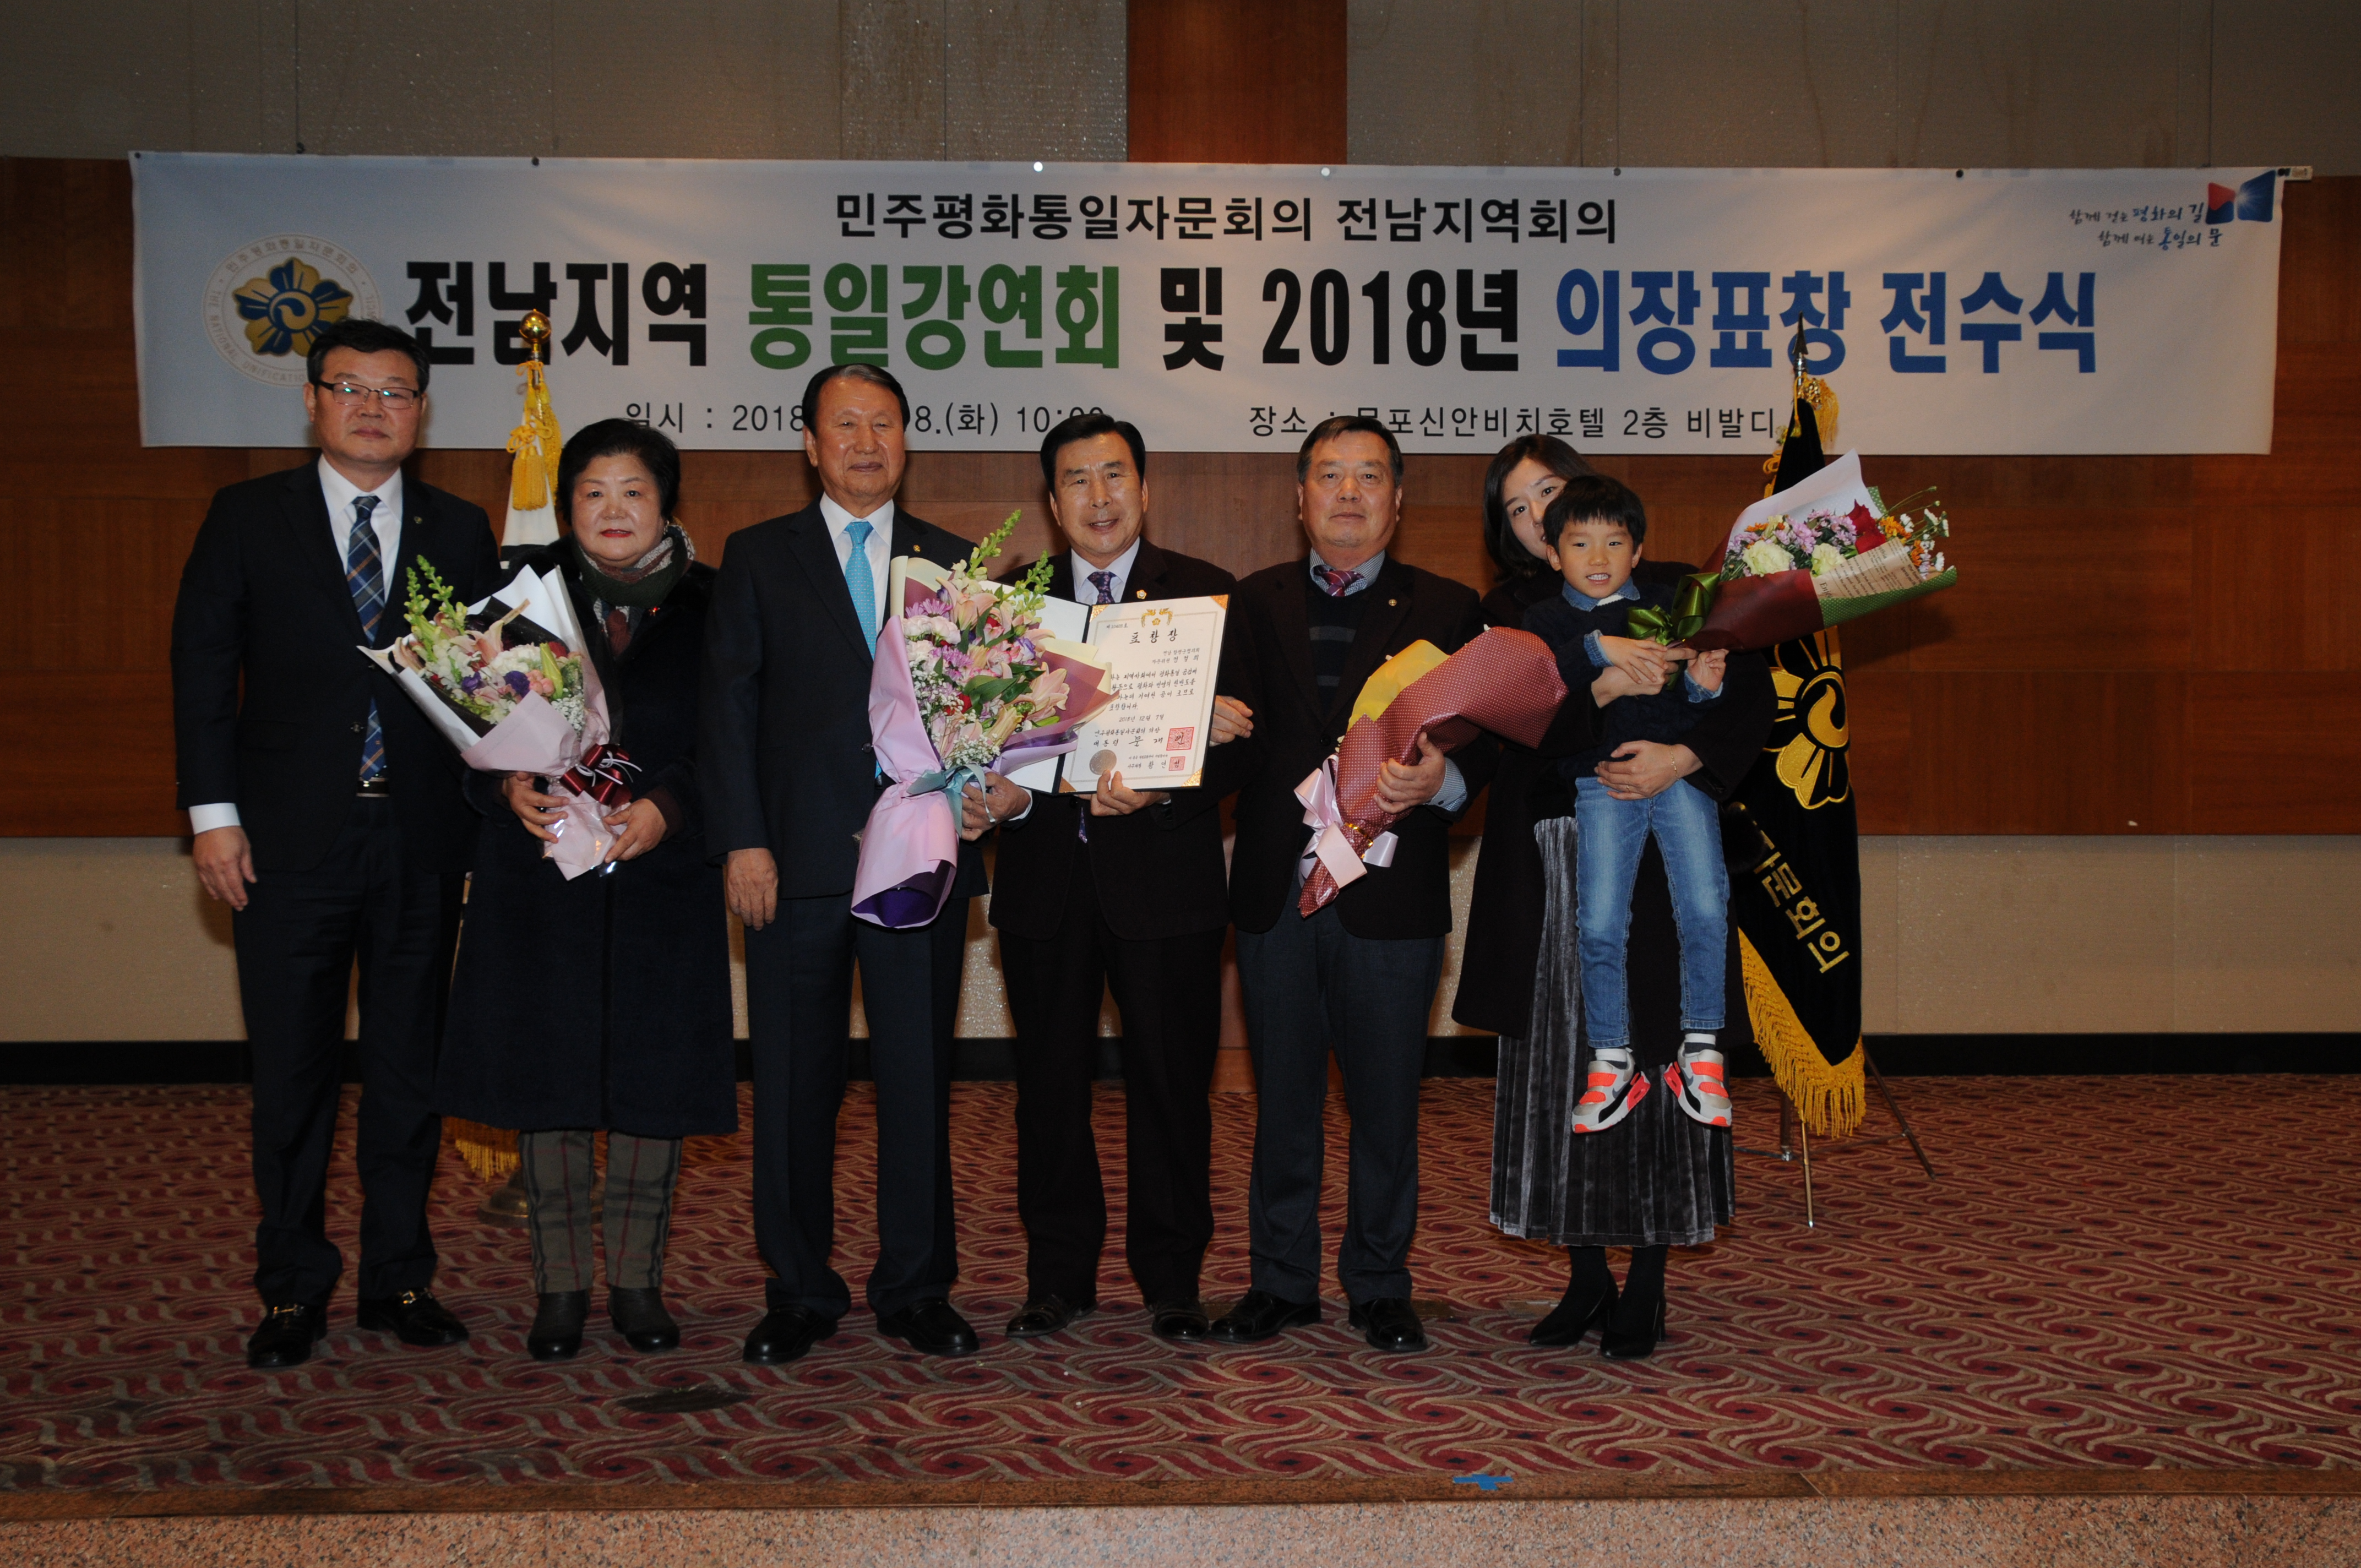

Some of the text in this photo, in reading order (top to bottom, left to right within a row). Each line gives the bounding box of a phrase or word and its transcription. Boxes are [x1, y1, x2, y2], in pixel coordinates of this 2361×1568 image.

[836, 192, 1616, 243] 민주평화통일자문회의 전남지역회의
[2069, 209, 2101, 224] 함께
[2133, 205, 2183, 222] 평화의
[2189, 202, 2205, 224] 길
[2098, 227, 2223, 251] 함께 여는 통일의 문
[405, 261, 2096, 375] 전남지역 통일강연회 및 2018년 의장표창 전수식
[627, 402, 683, 433] 일시
[915, 402, 998, 437] 8.(화)
[1017, 406, 1103, 433] 10:
[1249, 406, 1308, 437] 장소
[1623, 407, 1668, 439] 2층
[1687, 408, 1773, 438] 비발디
